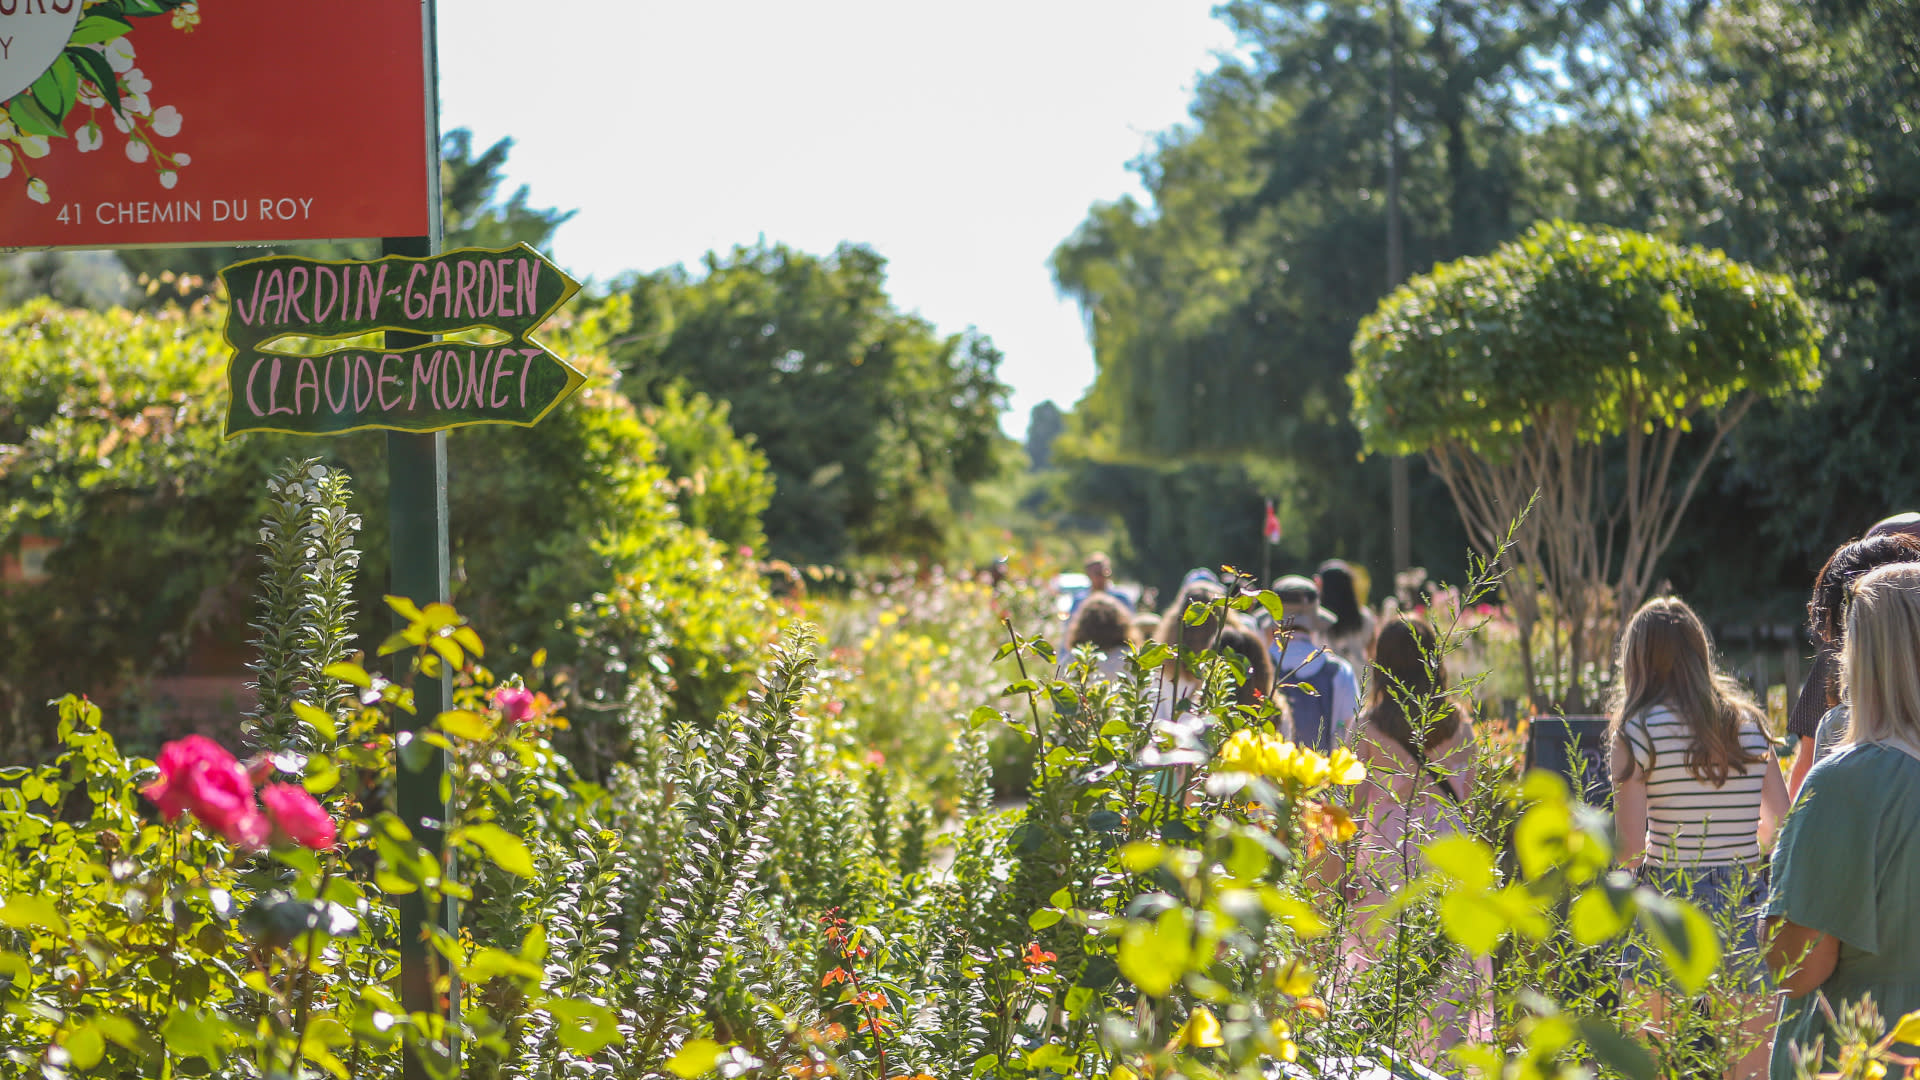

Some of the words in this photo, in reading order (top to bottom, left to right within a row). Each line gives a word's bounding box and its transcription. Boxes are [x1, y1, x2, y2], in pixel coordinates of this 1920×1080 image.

[55, 203, 82, 225] 41
[96, 200, 201, 225] CHEMIN
[212, 199, 249, 222] DU
[259, 197, 314, 221] ROY
[246, 353, 404, 416] CLAUDE
[408, 348, 544, 411] MONET
